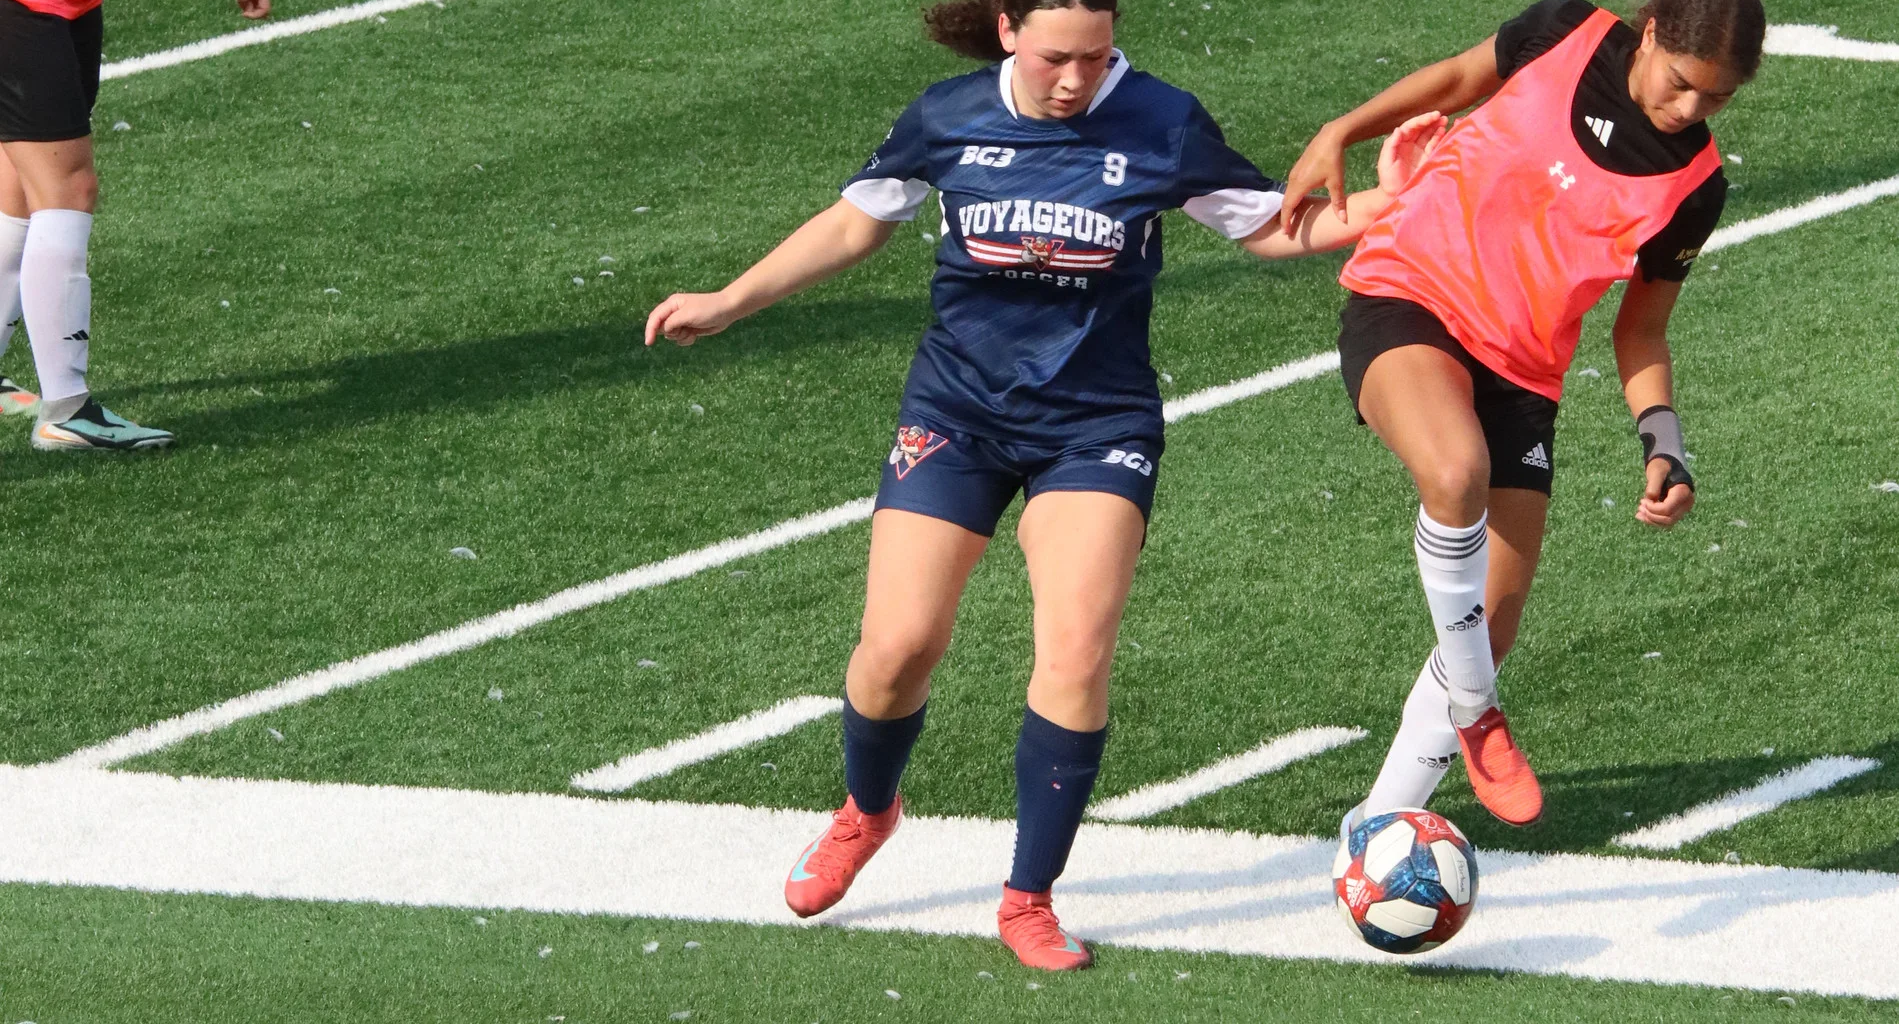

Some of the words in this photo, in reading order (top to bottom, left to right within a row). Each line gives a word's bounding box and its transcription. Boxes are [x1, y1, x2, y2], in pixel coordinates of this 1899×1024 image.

[958, 145, 1016, 168] BG3
[1102, 152, 1128, 187] 9
[958, 199, 1126, 252] VOYAGEURS
[987, 269, 1089, 290] OCCER
[1100, 449, 1153, 476] BG3
